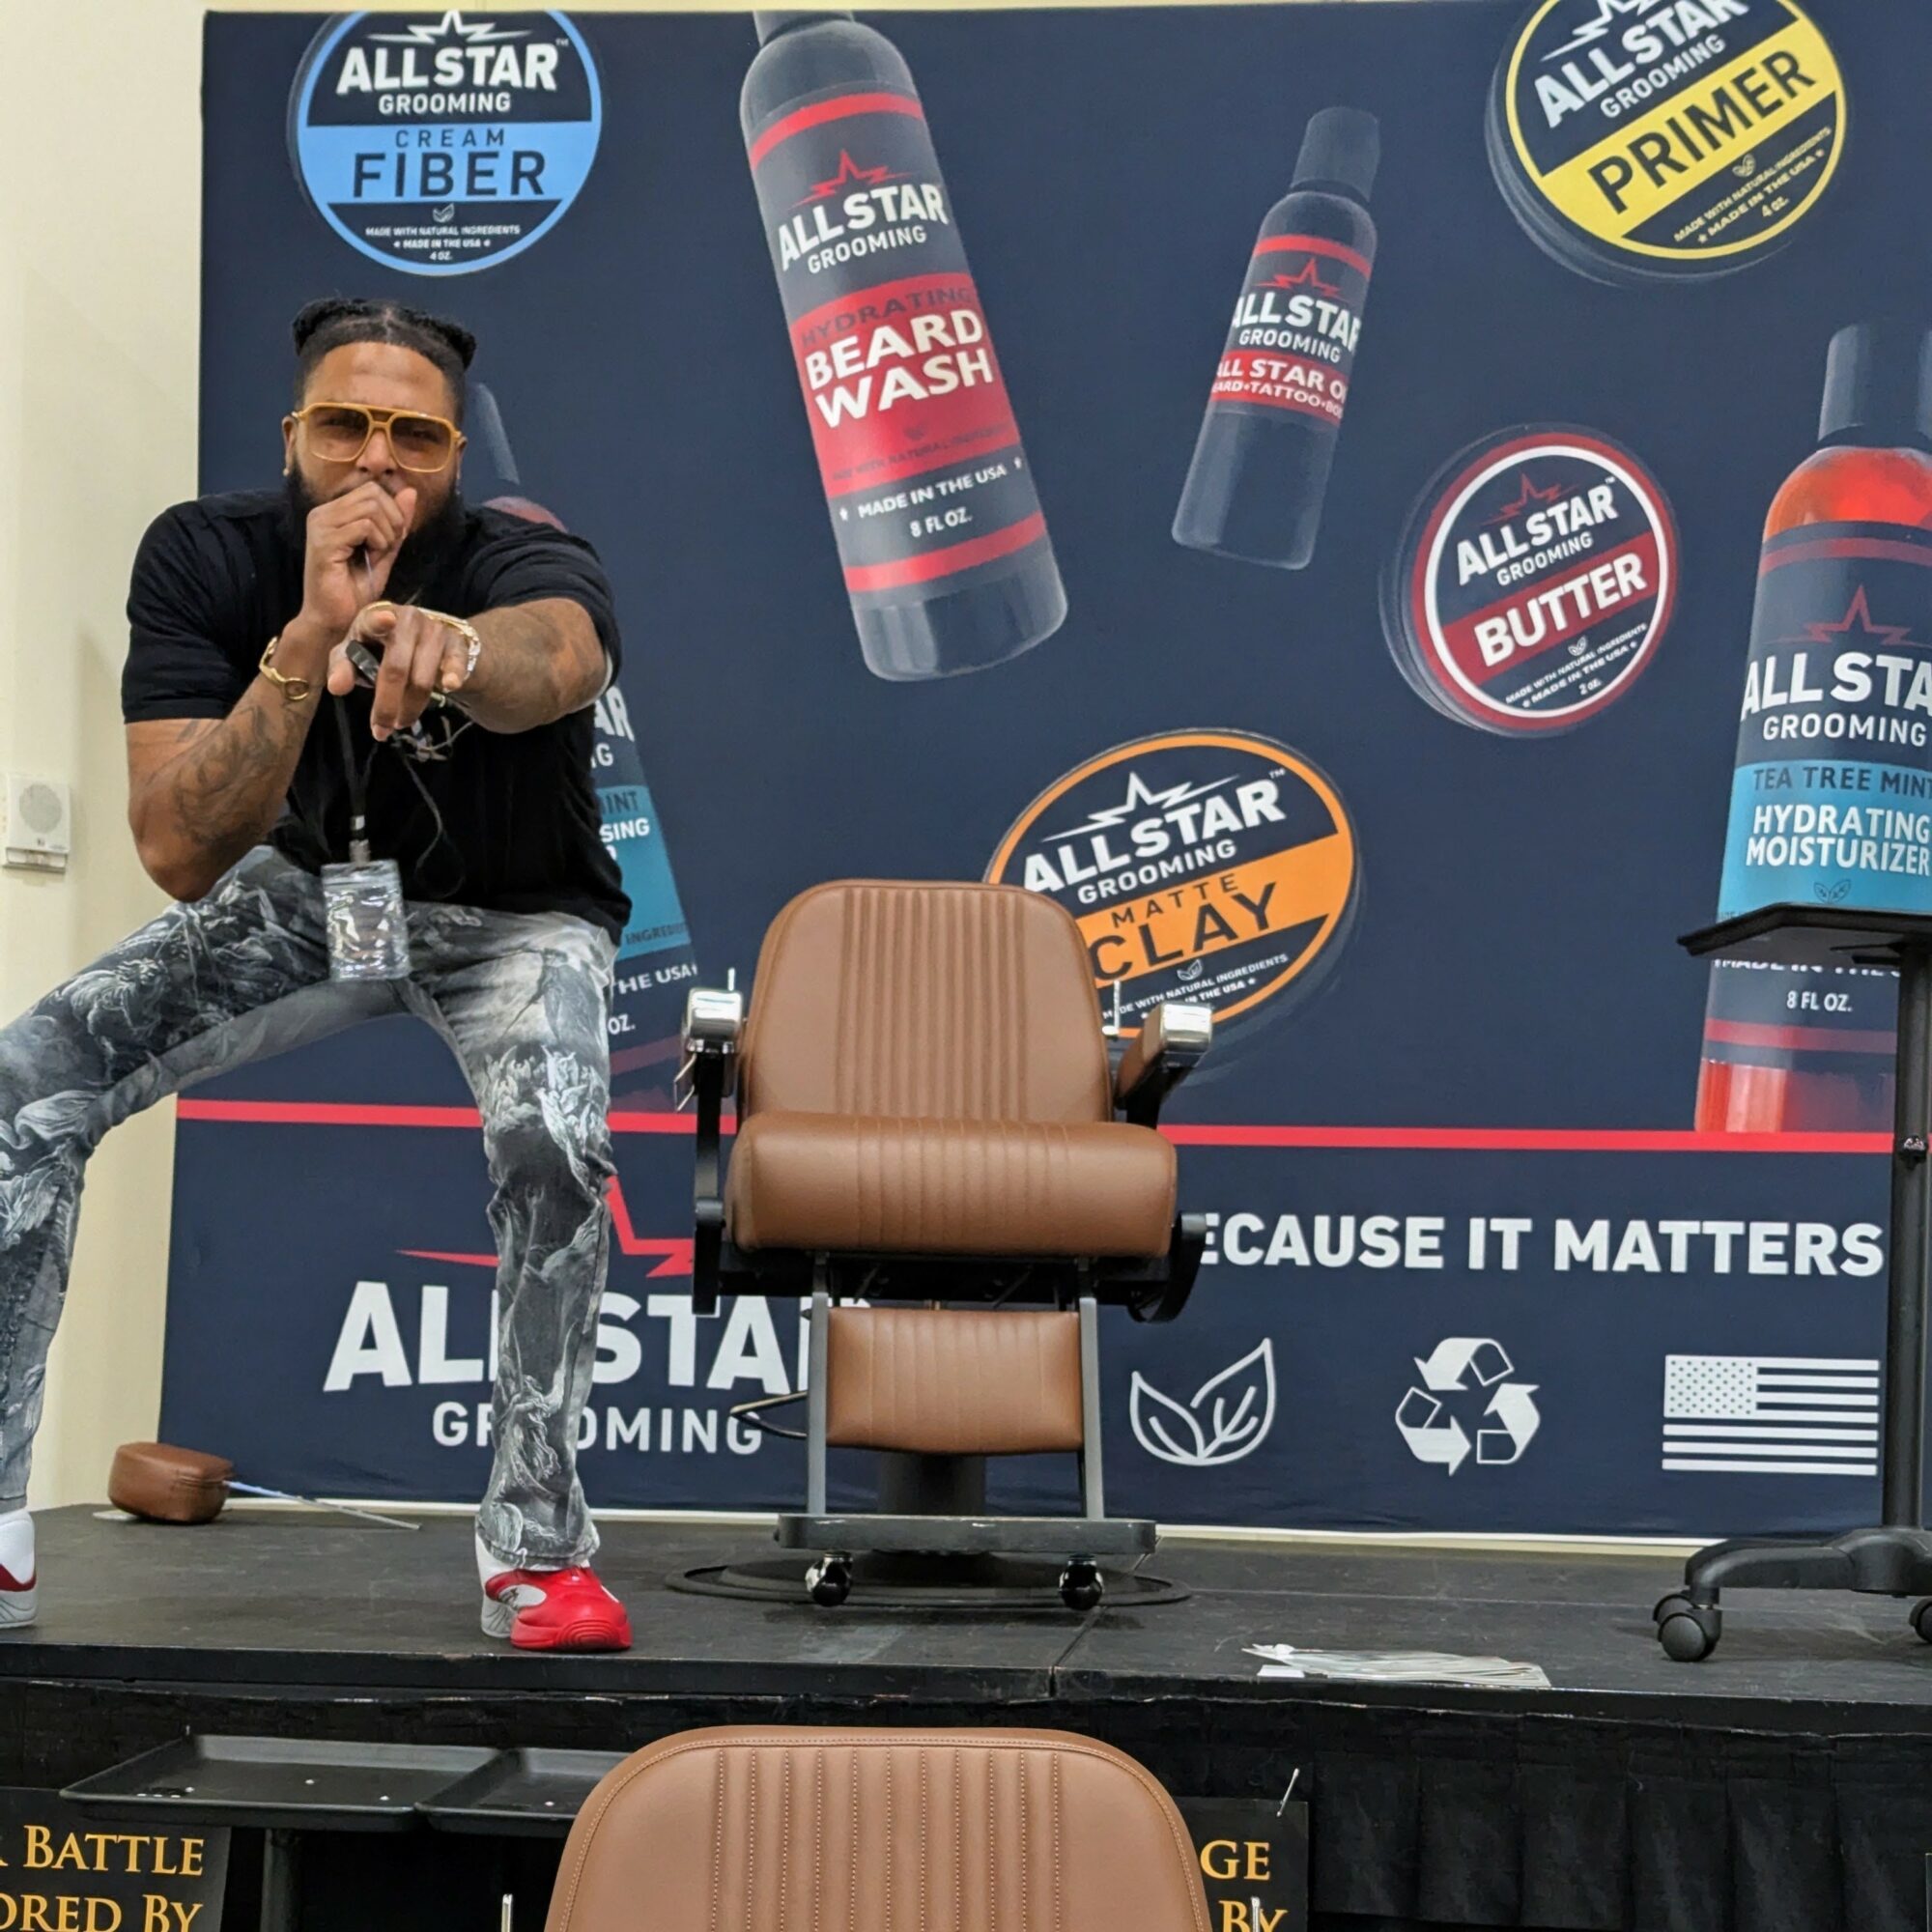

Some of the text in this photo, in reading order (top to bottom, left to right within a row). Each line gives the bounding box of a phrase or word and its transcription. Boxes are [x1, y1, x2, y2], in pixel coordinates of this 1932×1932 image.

[378, 92, 511, 114] GROOMING
[1600, 34, 1726, 118] GROOMING
[395, 128, 505, 148] CREAM
[1586, 49, 1817, 215] PRIMER
[353, 151, 546, 198] FIBER
[1708, 203, 1748, 236] MADE
[1747, 192, 1765, 207] IN
[1764, 172, 1790, 193] THE
[808, 225, 926, 274] GROOMING
[801, 287, 976, 347] HYDRATING
[805, 309, 983, 390] BEARD
[1239, 328, 1341, 363] GROOMING
[815, 348, 993, 428] WASH
[1249, 359, 1324, 391] STAR
[858, 464, 1007, 518] MADE IN THE USA
[910, 521, 922, 538] 8
[925, 516, 944, 533] FL
[1497, 531, 1593, 586] GROOMING
[1474, 553, 1647, 667] BUTTER
[1531, 644, 1629, 702] MADE IN THE USA
[1741, 652, 1823, 722] ALL
[1763, 713, 1926, 747] GROOMING
[1753, 768, 1793, 790] TEA
[1804, 767, 1872, 791] TREE
[1753, 804, 1930, 844] HYDRATING
[1078, 838, 1237, 904] GROOMING
[1746, 837, 1930, 877] MOISTURIZER
[1112, 873, 1238, 928] MATTE
[1087, 881, 1276, 980] CLAY
[1103, 953, 1289, 1020] MDE WITH NATURAL INGREDIENTS
[1199, 988, 1221, 1003] THE
[1223, 981, 1245, 994] USA
[1787, 990, 1853, 1012] 8 FL OZ.
[1468, 1217, 1532, 1270] IT
[1553, 1219, 1884, 1277] MATTERS
[23, 1825, 204, 1876] BATTLE
